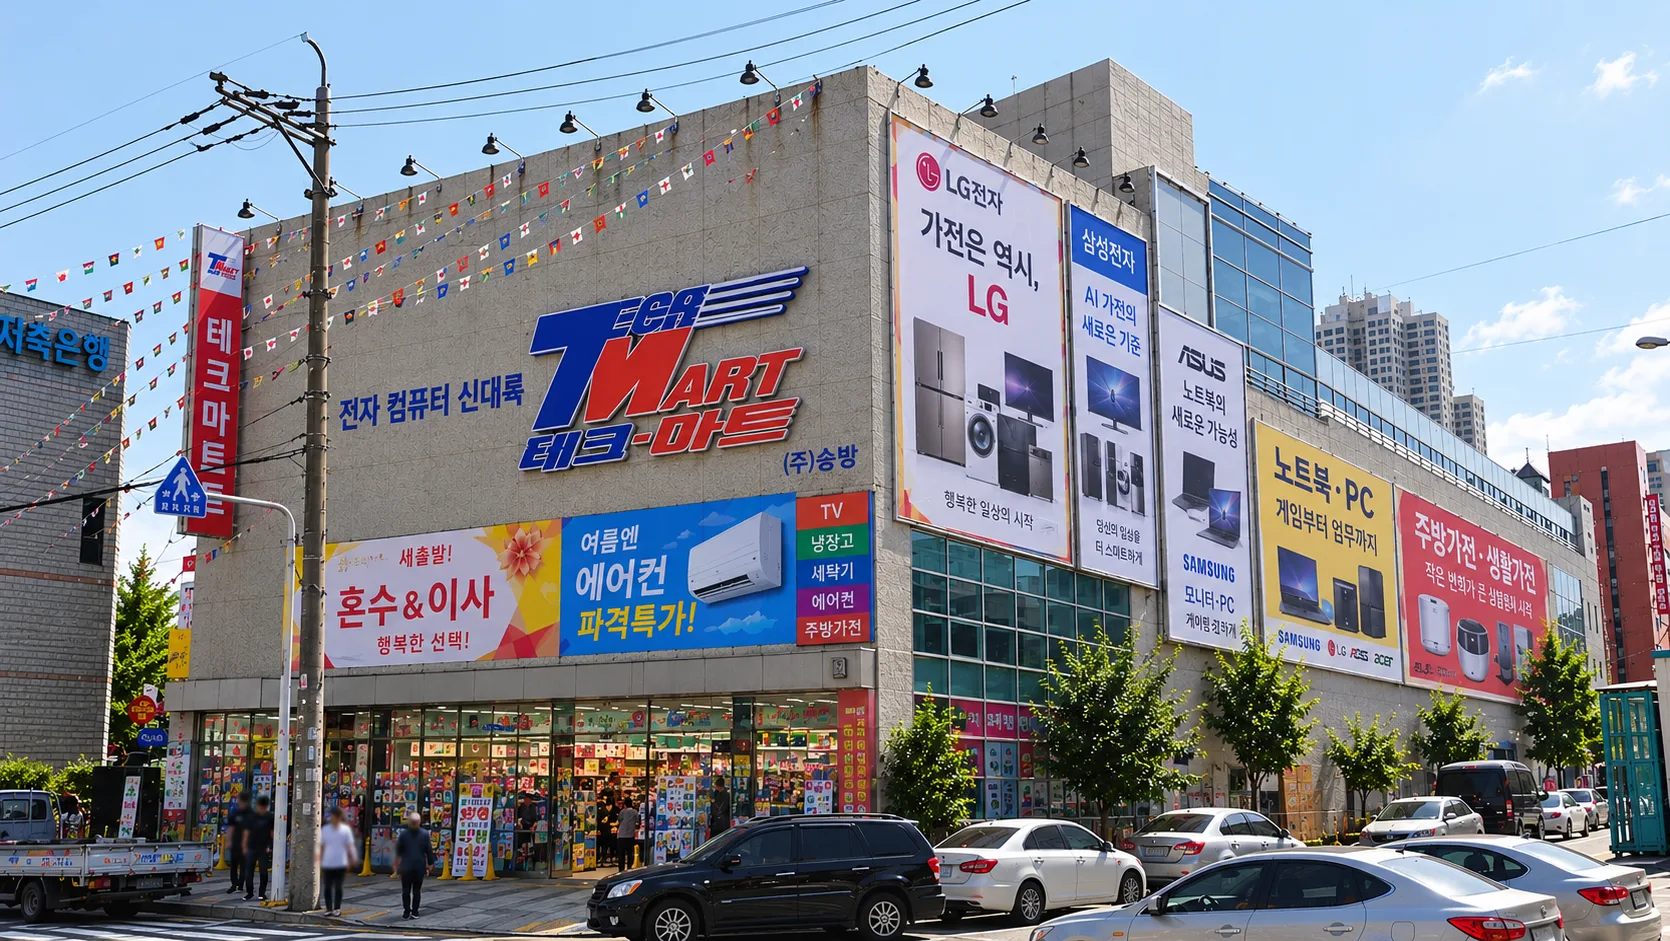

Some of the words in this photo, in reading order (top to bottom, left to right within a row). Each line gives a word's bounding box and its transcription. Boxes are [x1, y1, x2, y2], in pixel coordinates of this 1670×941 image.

[945, 167, 1003, 216] LG전자
[920, 207, 985, 267] 가전은
[993, 239, 1039, 291] 역시,
[1082, 227, 1136, 275] 삼성전자
[967, 274, 1009, 326] LG
[1084, 285, 1099, 309] AI
[1102, 292, 1137, 328] 가전의
[0, 315, 110, 372] 저축은행
[1119, 330, 1141, 358] 기준
[583, 325, 804, 424] MART
[1178, 344, 1226, 382] ASUS
[339, 394, 380, 431] 전자
[387, 383, 450, 424] 컴퓨터
[457, 372, 525, 413] 신대륙
[1182, 379, 1226, 416] 노트북의
[1171, 405, 1205, 437] 새로운
[1207, 419, 1238, 449] 가능성
[782, 444, 858, 476] (주)송방
[820, 502, 843, 520] TV
[943, 490, 977, 514] 행복한
[980, 500, 1011, 525] 일상의
[1013, 511, 1034, 531] 시작
[1276, 498, 1329, 540] 게임부터
[1331, 519, 1378, 557] 업무까지
[399, 544, 453, 568] 새출발!
[580, 524, 640, 556] 여름엔
[811, 532, 855, 553] 냉장고
[575, 554, 668, 602] 에어컨
[811, 561, 854, 582] 세탁기
[1183, 553, 1235, 583] SAMSUNG
[1424, 561, 1445, 588] 작은
[811, 590, 854, 611] 에어컨
[577, 600, 697, 642] 파격특가!
[804, 619, 861, 639] 주방가전
[377, 632, 424, 656] 행복한
[431, 631, 470, 652] 선택!
[1278, 629, 1321, 652] SAMSUNG
[1336, 644, 1347, 656] LG
